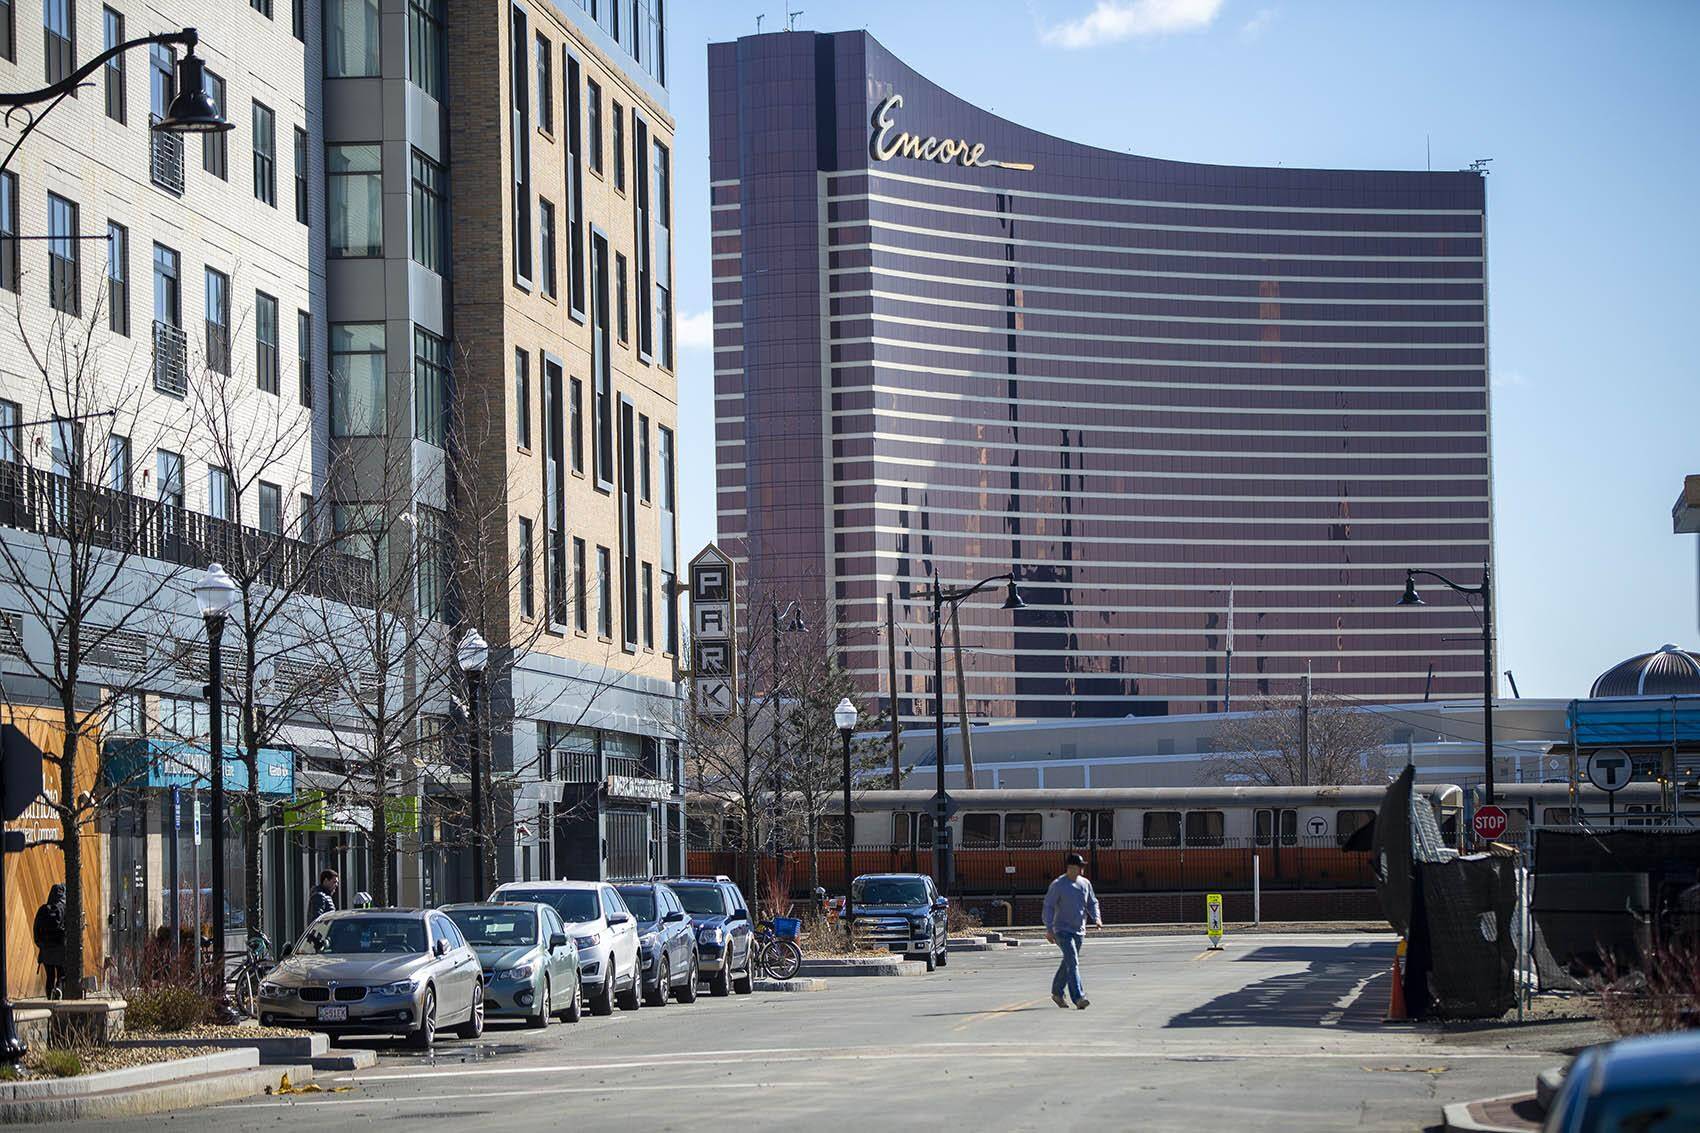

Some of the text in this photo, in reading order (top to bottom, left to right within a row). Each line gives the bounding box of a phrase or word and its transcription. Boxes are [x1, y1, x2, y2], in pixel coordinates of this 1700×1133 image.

[870, 94, 1034, 171] Encore
[700, 572, 725, 709] PARK
[1596, 759, 1625, 785] T
[1310, 822, 1324, 835] T
[1475, 816, 1505, 829] STOP
